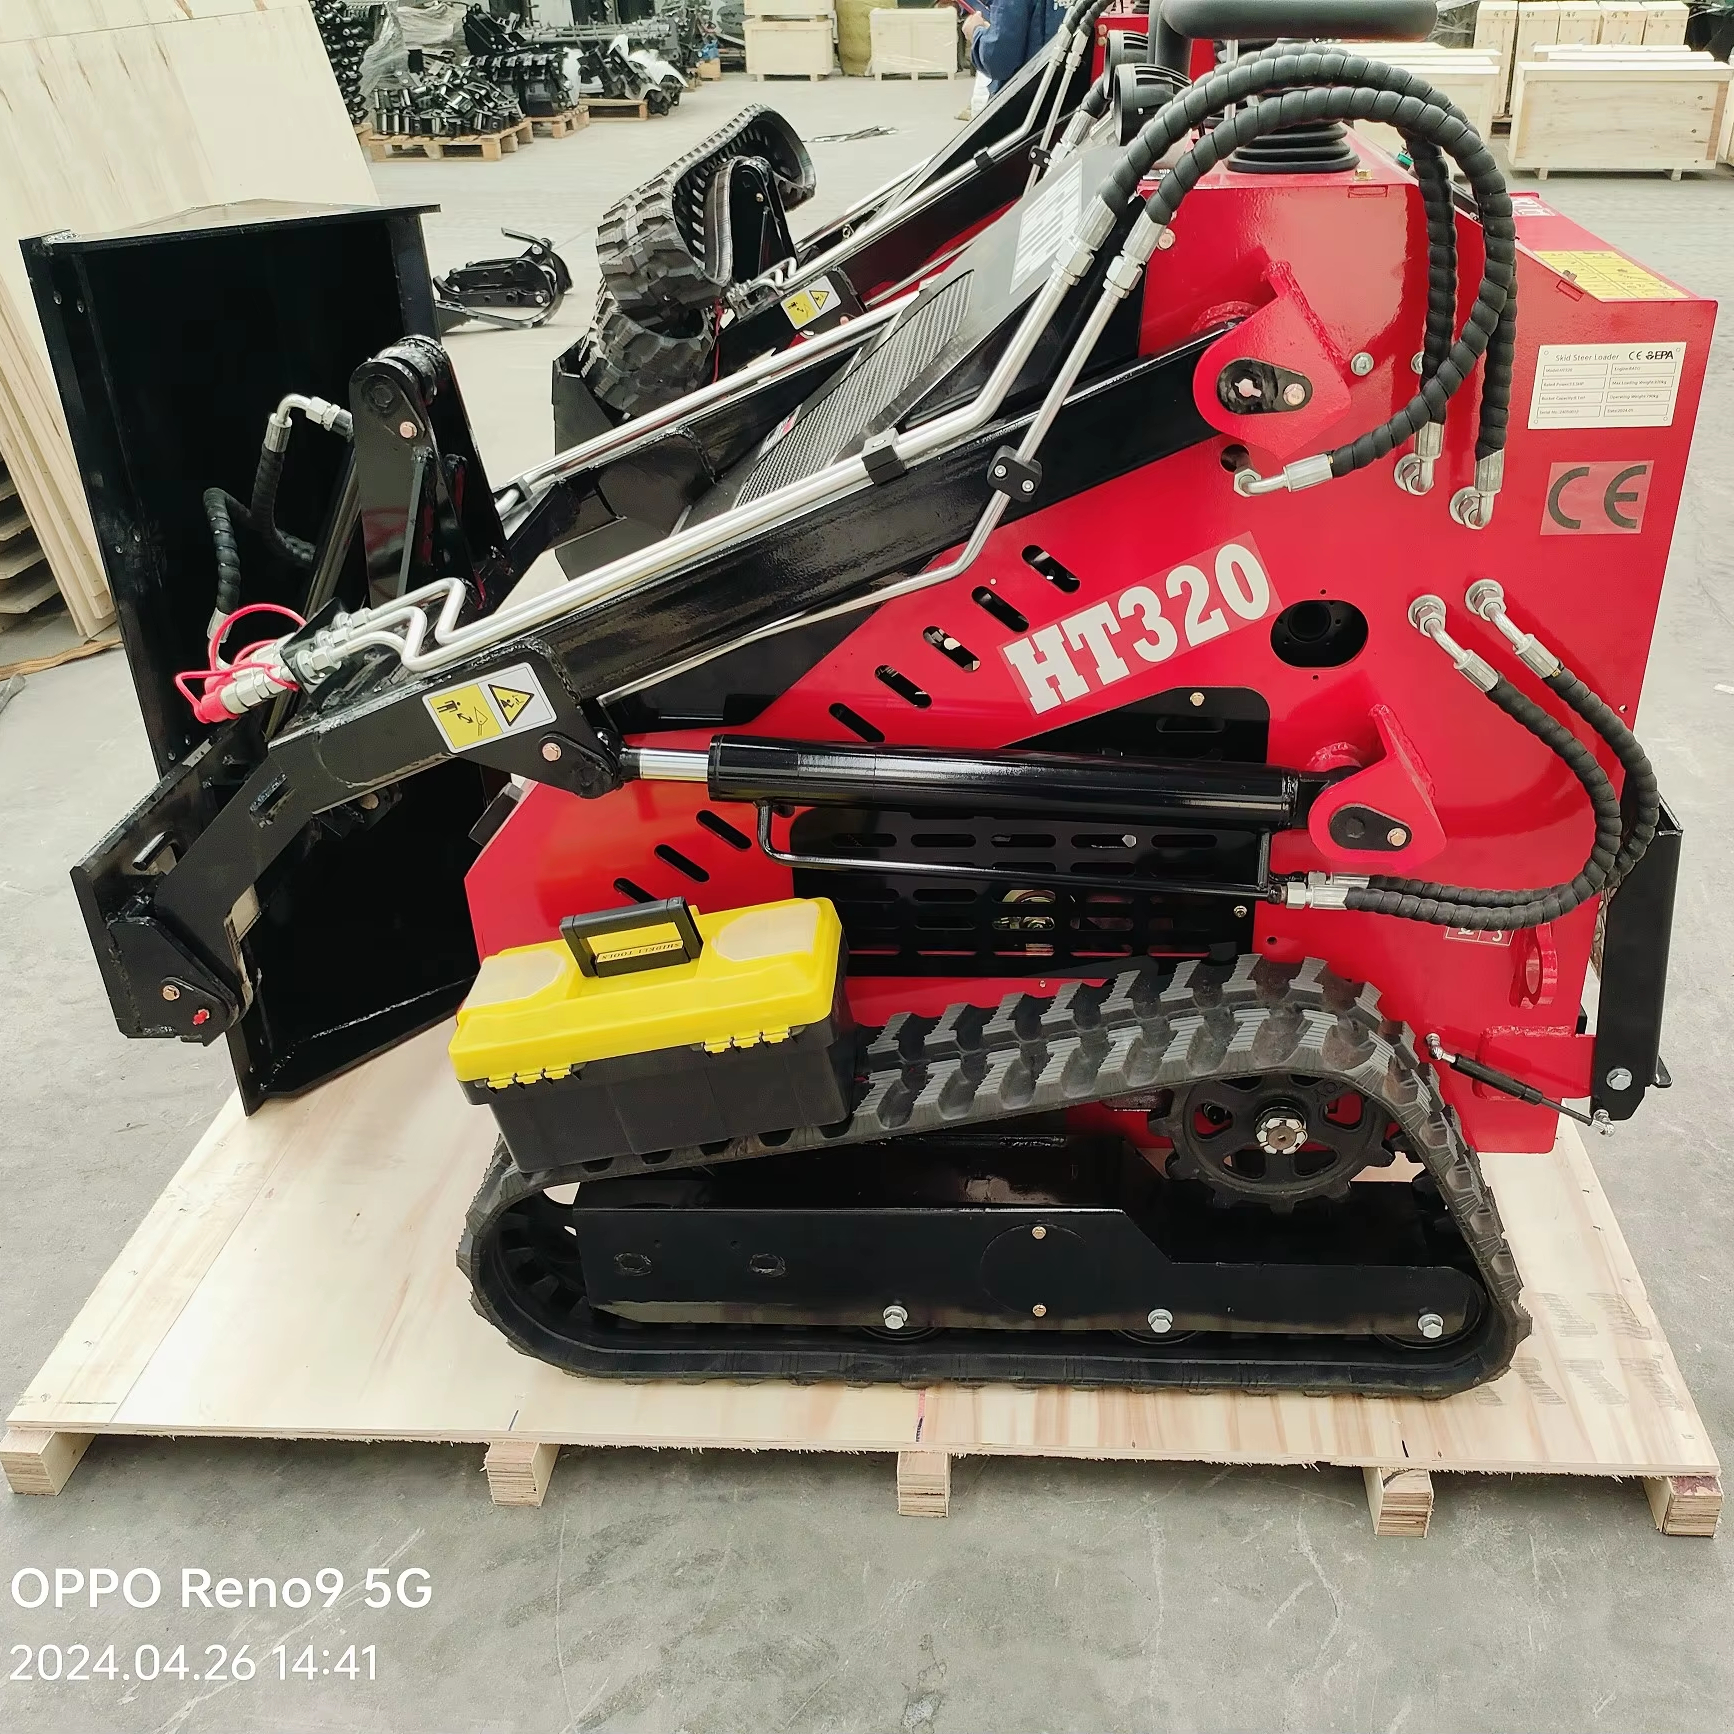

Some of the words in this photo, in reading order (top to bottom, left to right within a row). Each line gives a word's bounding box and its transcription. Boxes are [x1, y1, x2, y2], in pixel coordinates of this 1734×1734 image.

[1594, 353, 1620, 361] Loader
[1655, 351, 1674, 359] EPA
[1548, 465, 1647, 529] CE
[1003, 544, 1270, 714] HT320
[602, 951, 633, 960] TOOLS
